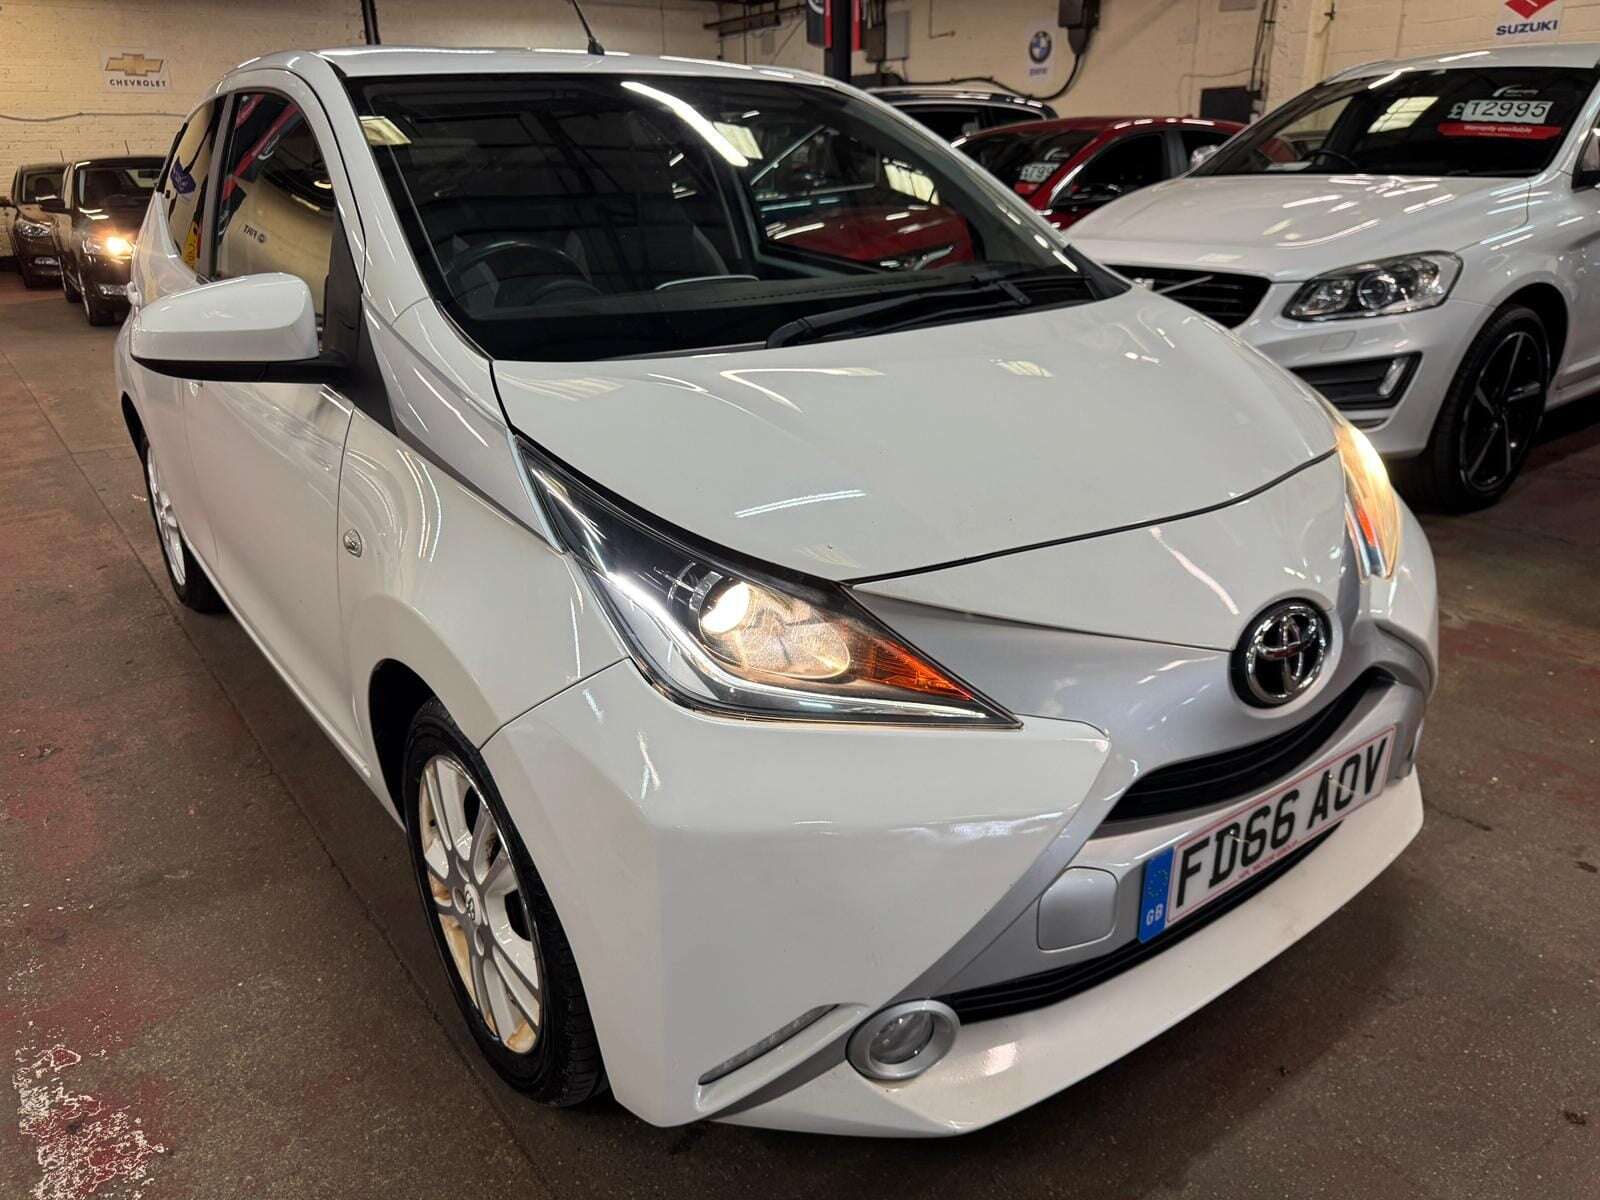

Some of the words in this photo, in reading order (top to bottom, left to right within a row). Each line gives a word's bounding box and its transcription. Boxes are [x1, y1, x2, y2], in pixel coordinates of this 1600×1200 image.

[1496, 20, 1558, 35] SUZUKI
[109, 79, 166, 87] CHEVROLET
[1447, 102, 1546, 119] £12995
[1175, 789, 1300, 908] FD66
[1307, 738, 1387, 829] AOV
[1145, 903, 1164, 926] GB
